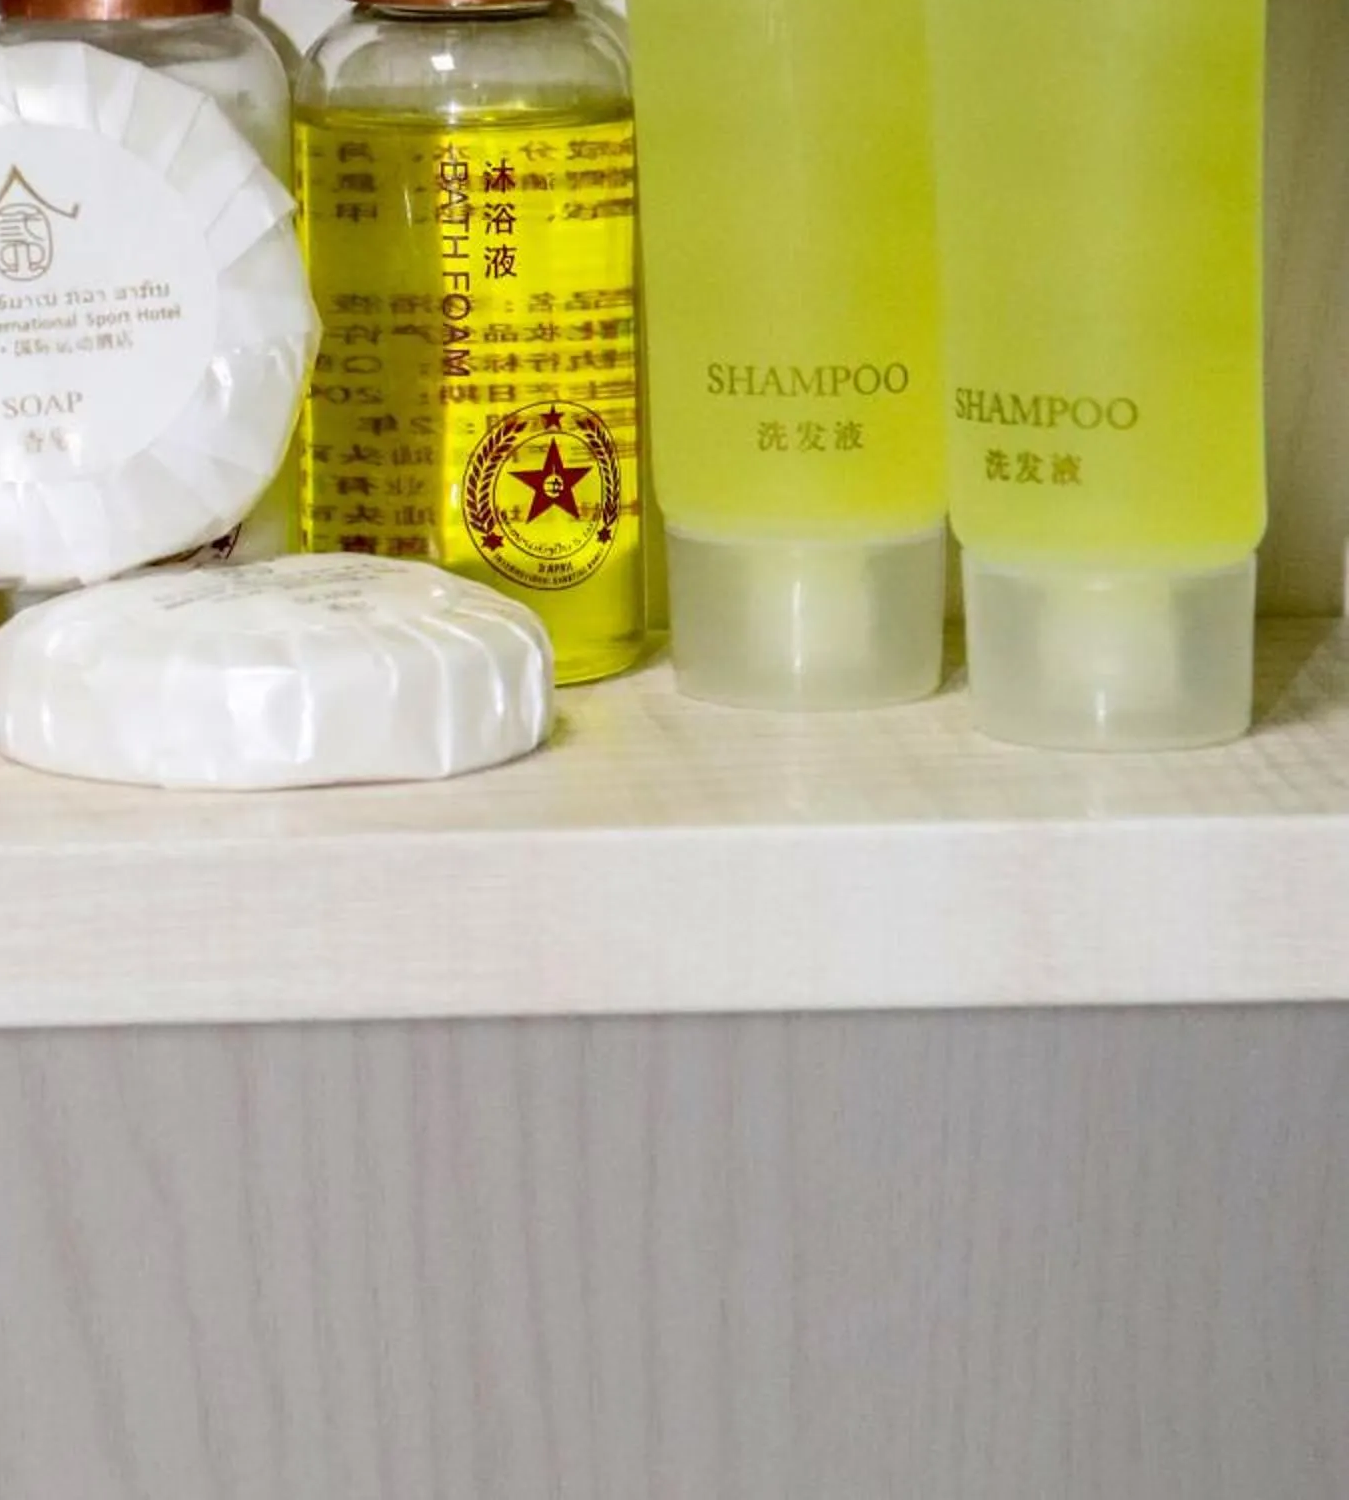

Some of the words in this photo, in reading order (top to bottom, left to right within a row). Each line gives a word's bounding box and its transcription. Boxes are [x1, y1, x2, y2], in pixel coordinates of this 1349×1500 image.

[439, 161, 471, 260] BATH
[482, 160, 518, 280] 沐浴液
[86, 311, 130, 330] Sport
[137, 303, 180, 322] Hotel
[441, 271, 471, 378] FOAM
[706, 362, 910, 399] SHAMPOO
[1, 391, 84, 420] SOAP
[954, 387, 1139, 431] SHAMPOO
[757, 420, 865, 453] 洗发液
[984, 448, 1083, 487] 洗发液
